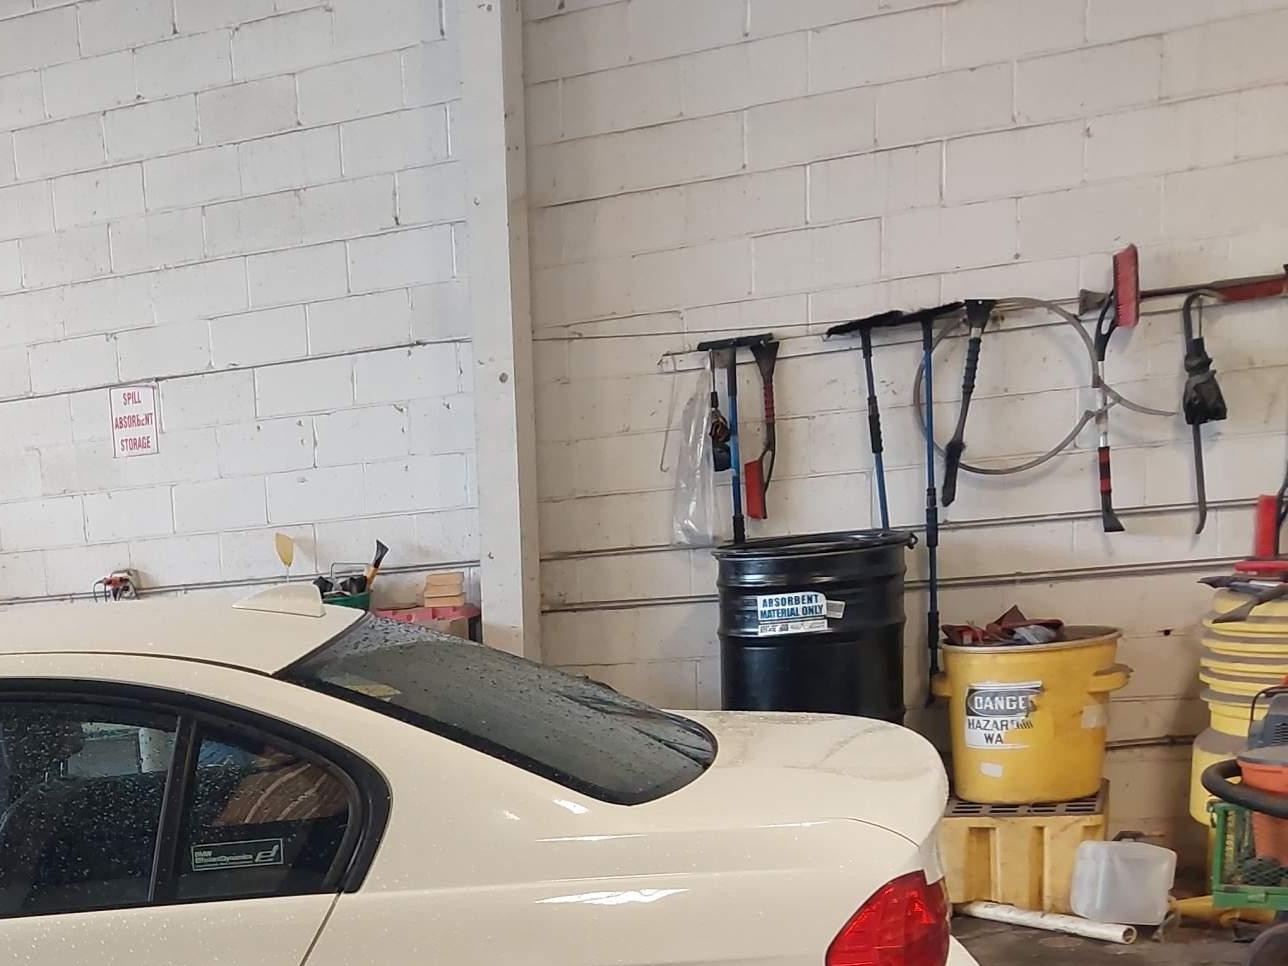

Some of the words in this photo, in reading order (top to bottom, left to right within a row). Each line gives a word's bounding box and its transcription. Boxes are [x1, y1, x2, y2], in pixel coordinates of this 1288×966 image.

[123, 391, 142, 406] SPILL
[120, 435, 151, 452] STORAGE
[762, 594, 819, 609] ABSORBENT
[759, 607, 800, 619] MATERIAL
[801, 604, 824, 616] ONLY
[973, 695, 1030, 710] DANGE
[968, 718, 1015, 731] HAZAR
